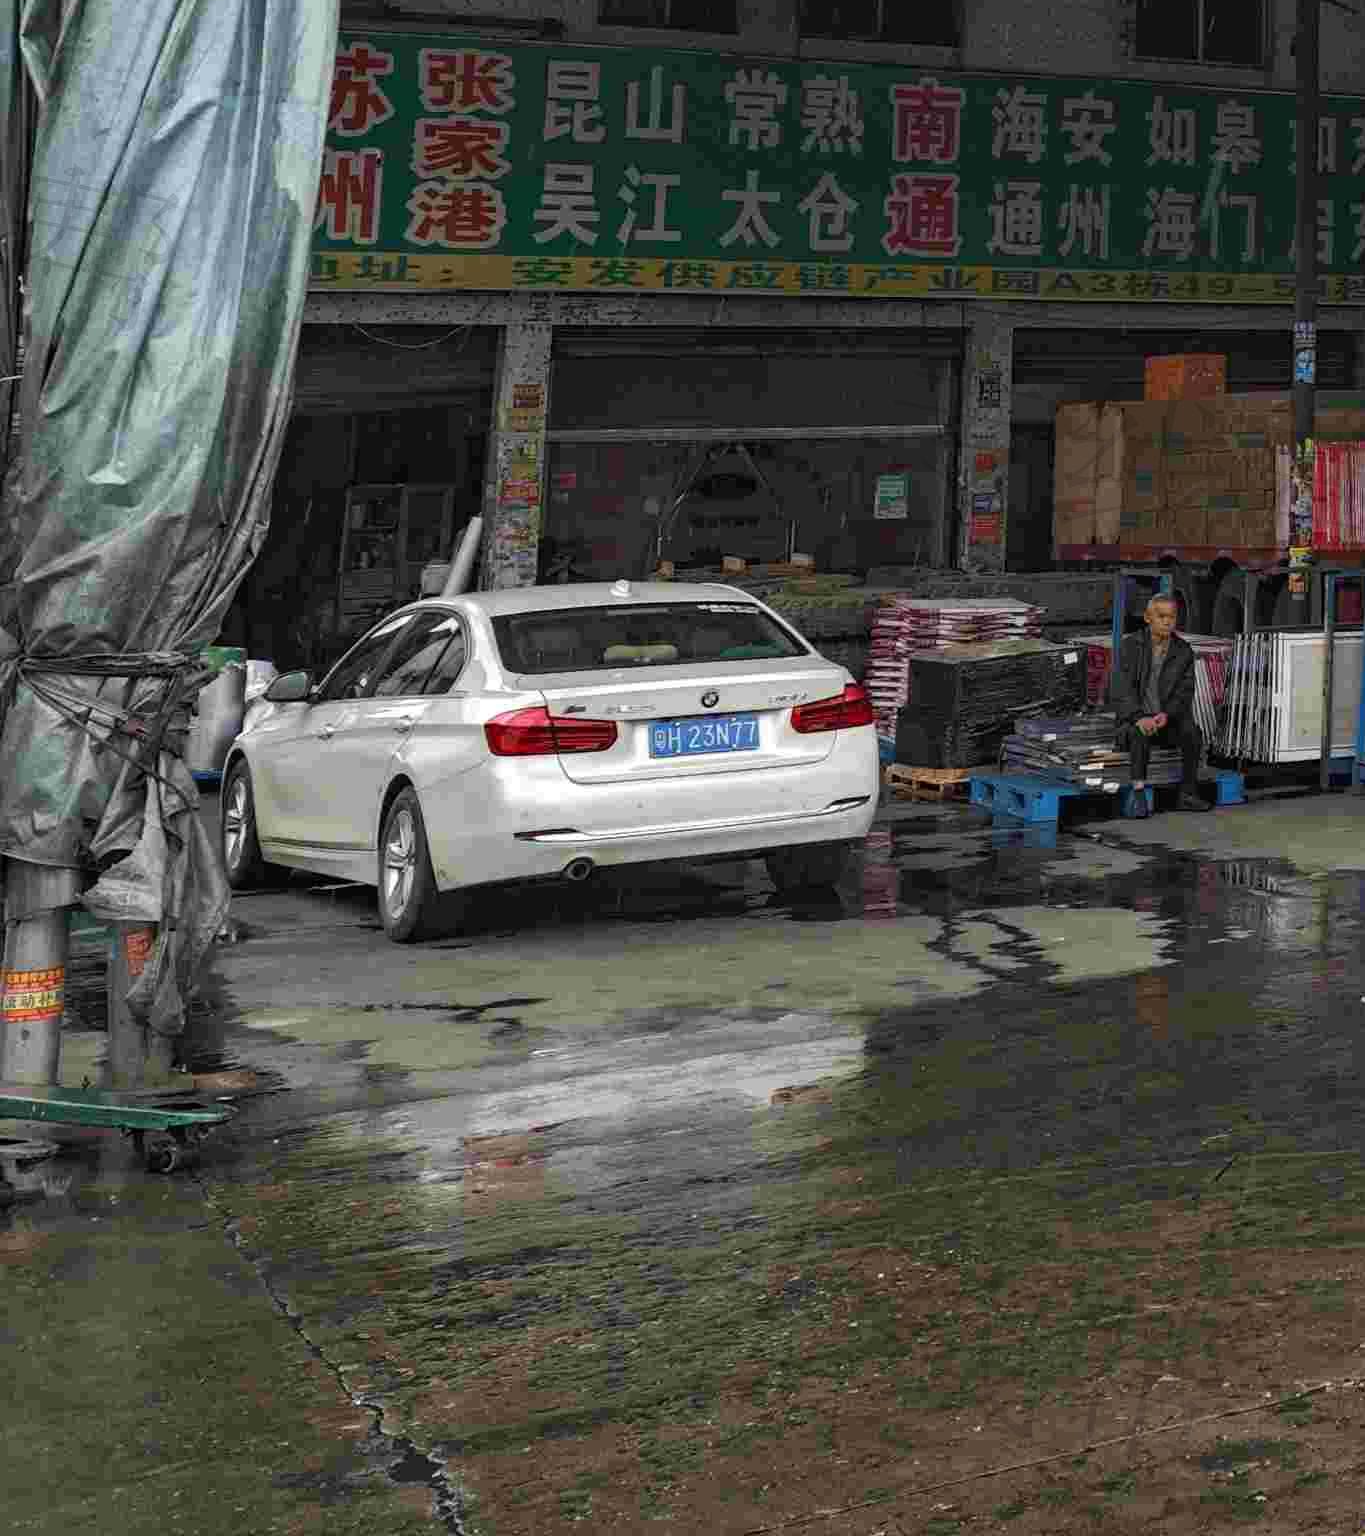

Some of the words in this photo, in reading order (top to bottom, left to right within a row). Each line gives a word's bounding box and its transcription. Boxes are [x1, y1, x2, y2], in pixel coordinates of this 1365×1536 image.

[314, 41, 395, 245] 苏州
[405, 47, 515, 250] 张家港
[543, 58, 687, 144] 昆山
[724, 66, 864, 154] 常熟
[992, 86, 1116, 166] 海安
[1144, 92, 1263, 174] 如皋
[534, 163, 682, 247] 吴江
[720, 168, 858, 252] 太仓
[881, 75, 966, 257] 南通
[988, 182, 1110, 258] 通州
[1143, 187, 1257, 262] 海门
